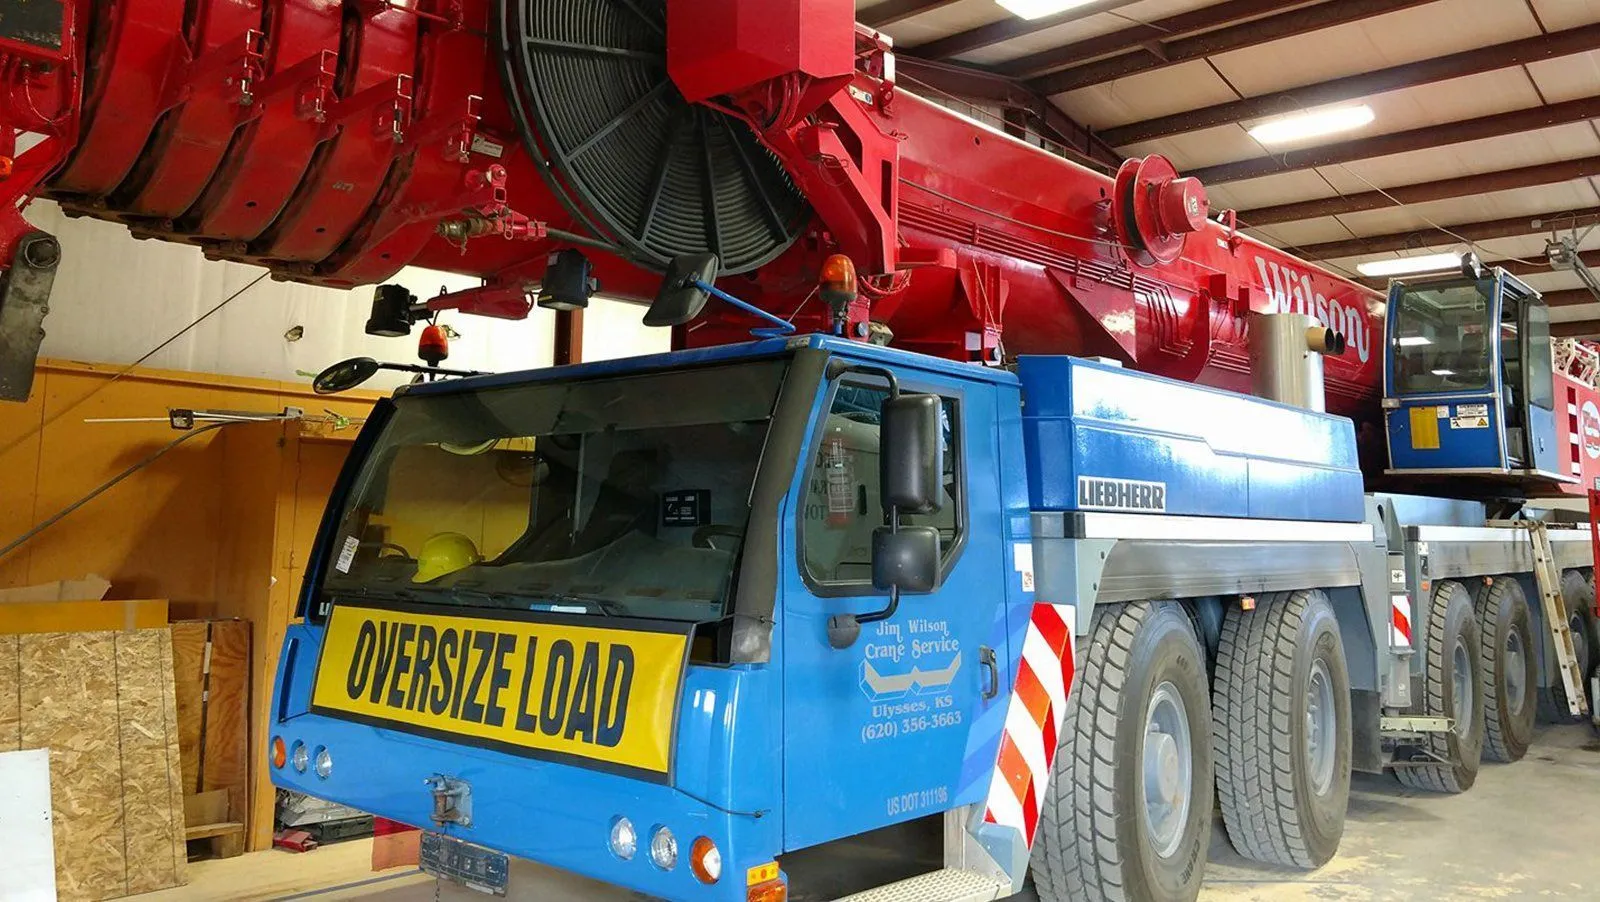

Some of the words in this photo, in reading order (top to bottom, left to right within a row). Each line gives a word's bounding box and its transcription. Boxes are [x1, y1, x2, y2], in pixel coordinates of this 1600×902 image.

[1254, 255, 1370, 363] Wilson
[1079, 479, 1164, 510] LIEBHERR
[876, 621, 904, 643] Jim
[908, 618, 950, 638] Wilson
[864, 643, 905, 663] Crane
[911, 636, 960, 659] Service
[346, 619, 517, 728] OVERSIZE
[515, 635, 635, 748] LOAD
[872, 701, 930, 720] Ulysses,
[934, 695, 953, 709] KS
[861, 721, 898, 744] (620)
[902, 711, 962, 734] 356-3663
[887, 796, 900, 816] US
[901, 791, 919, 812] DOT
